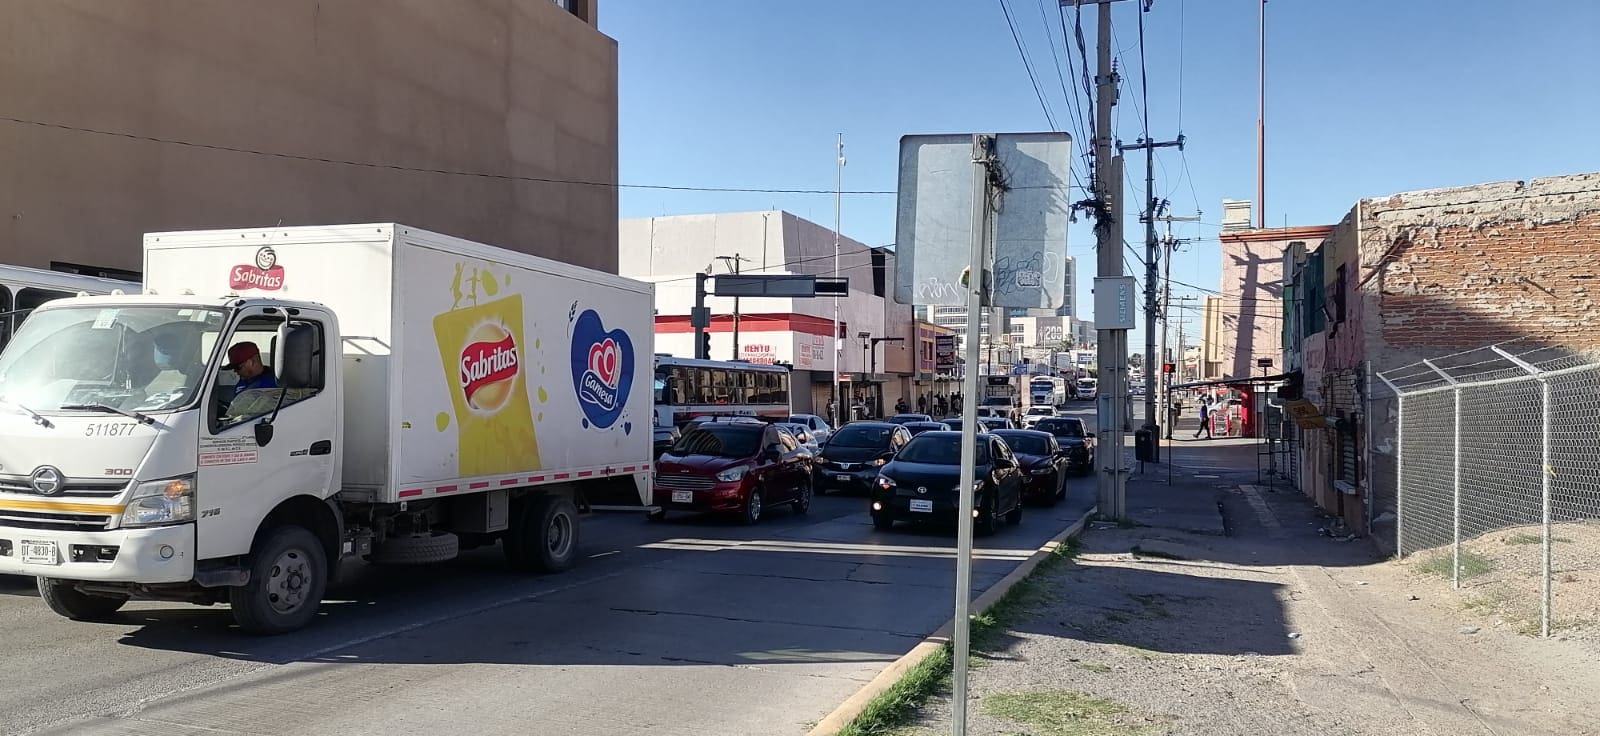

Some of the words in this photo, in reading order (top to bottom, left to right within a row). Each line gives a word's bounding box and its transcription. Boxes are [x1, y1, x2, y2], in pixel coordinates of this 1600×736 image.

[233, 267, 281, 287] Sabritas
[1119, 283, 1127, 323] SIEMENS
[461, 346, 518, 387] Sabritas
[585, 374, 613, 406] Gamesa
[85, 423, 138, 437] 511877
[104, 468, 133, 476] 300
